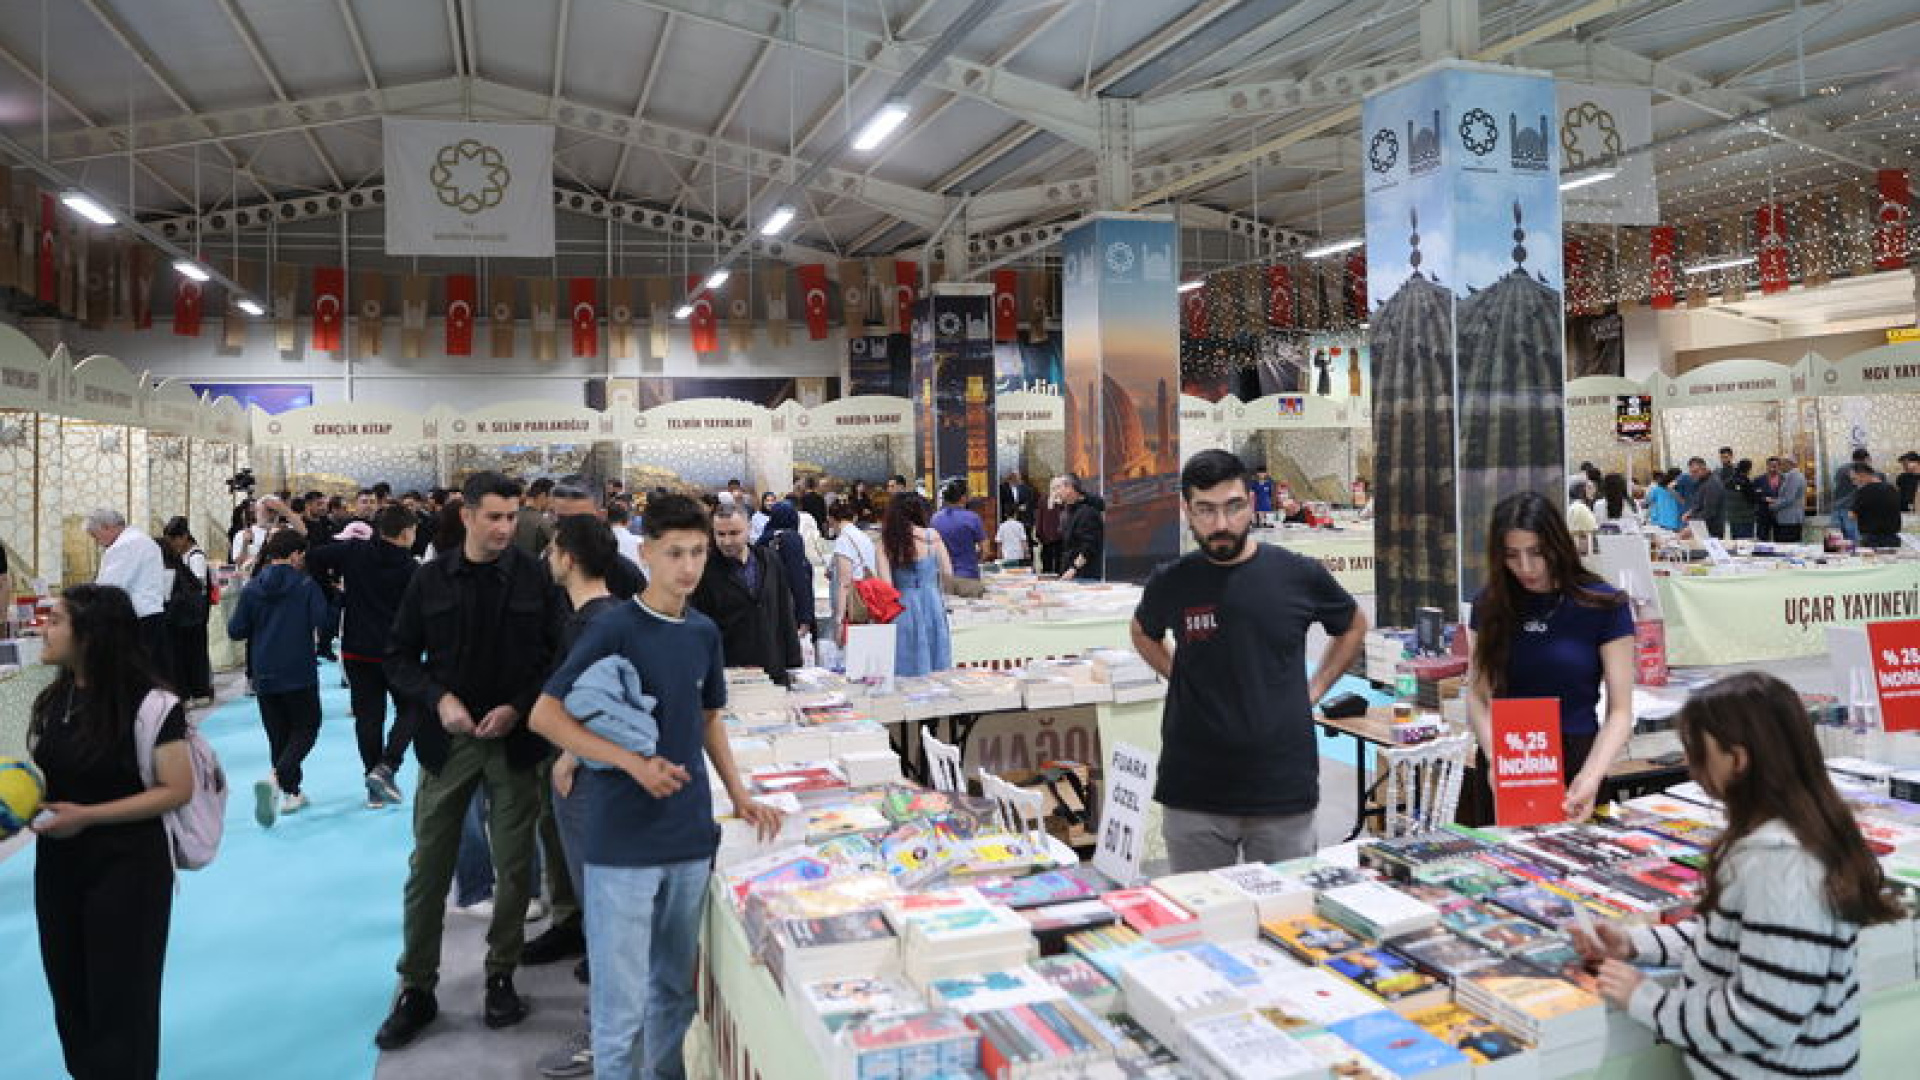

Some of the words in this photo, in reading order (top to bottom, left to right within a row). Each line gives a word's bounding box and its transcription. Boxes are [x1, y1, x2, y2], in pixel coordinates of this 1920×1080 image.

[1186, 614, 1218, 630] SOUL
[1785, 597, 1836, 631] UÇAR
[1842, 583, 1919, 619] YAYINEVİ
[1112, 750, 1147, 780] FUARA
[1496, 749, 1557, 775] İNDİRİM
[1112, 783, 1139, 813] ÖZEL
